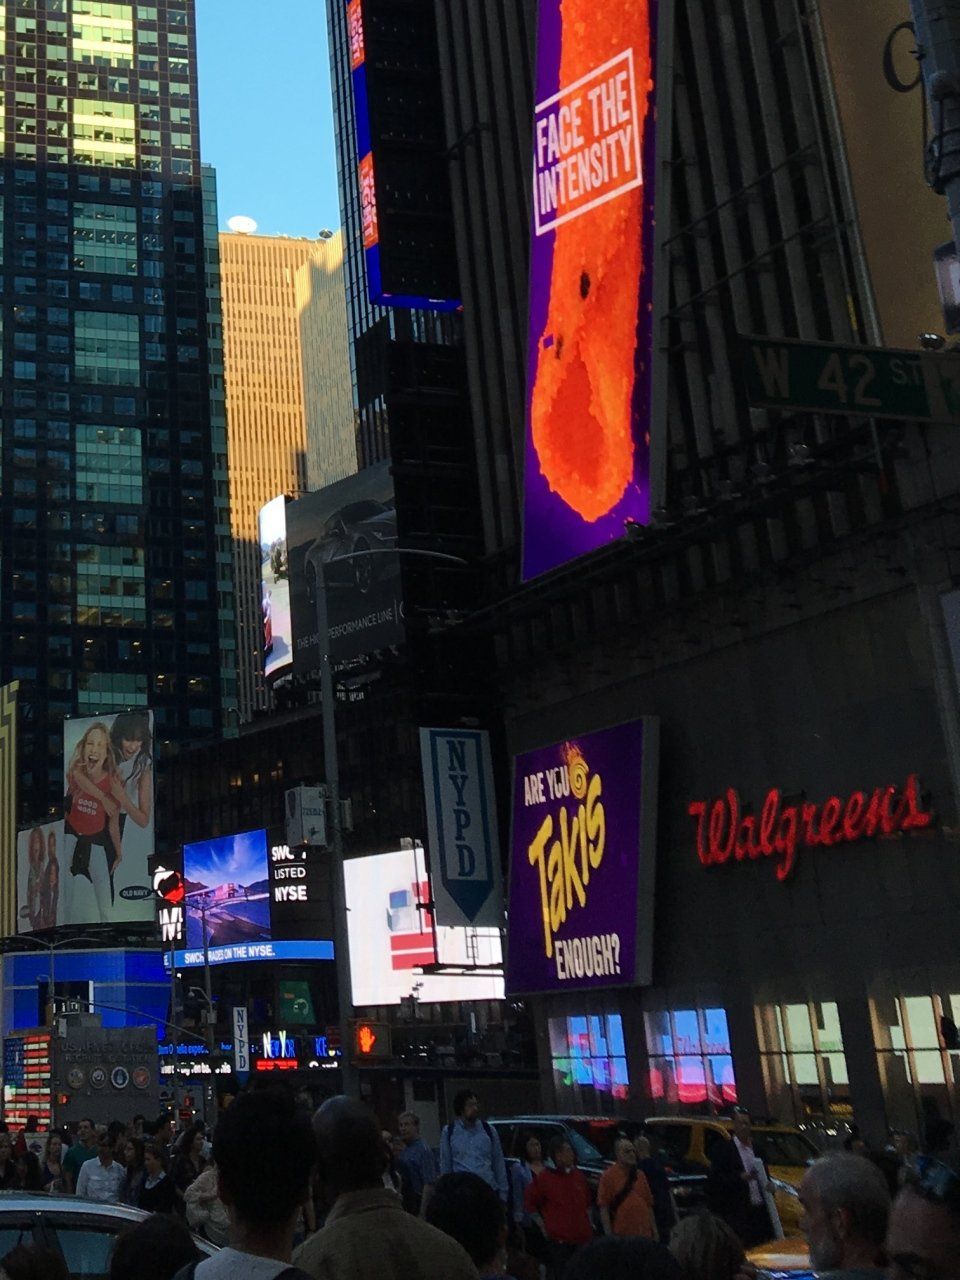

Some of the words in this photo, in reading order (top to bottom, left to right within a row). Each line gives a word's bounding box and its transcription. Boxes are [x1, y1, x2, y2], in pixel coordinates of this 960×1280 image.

[536, 96, 585, 168] FACE
[587, 70, 630, 137] THE
[538, 124, 633, 215] INTENSITY
[751, 344, 790, 400] W
[816, 350, 883, 408] 42
[78, 798, 98, 809] GOOD
[446, 739, 476, 877] NYPD
[524, 770, 547, 806] ARE
[546, 765, 571, 800] YOU
[688, 773, 932, 881] Walgreens
[122, 888, 134, 898] OLD
[274, 866, 306, 880] LISTED
[274, 885, 308, 903] NYSE
[208, 949, 225, 962] RADES
[233, 946, 246, 959] THE
[555, 932, 621, 980] ENOUGH?
[236, 1009, 245, 1069] NYPD
